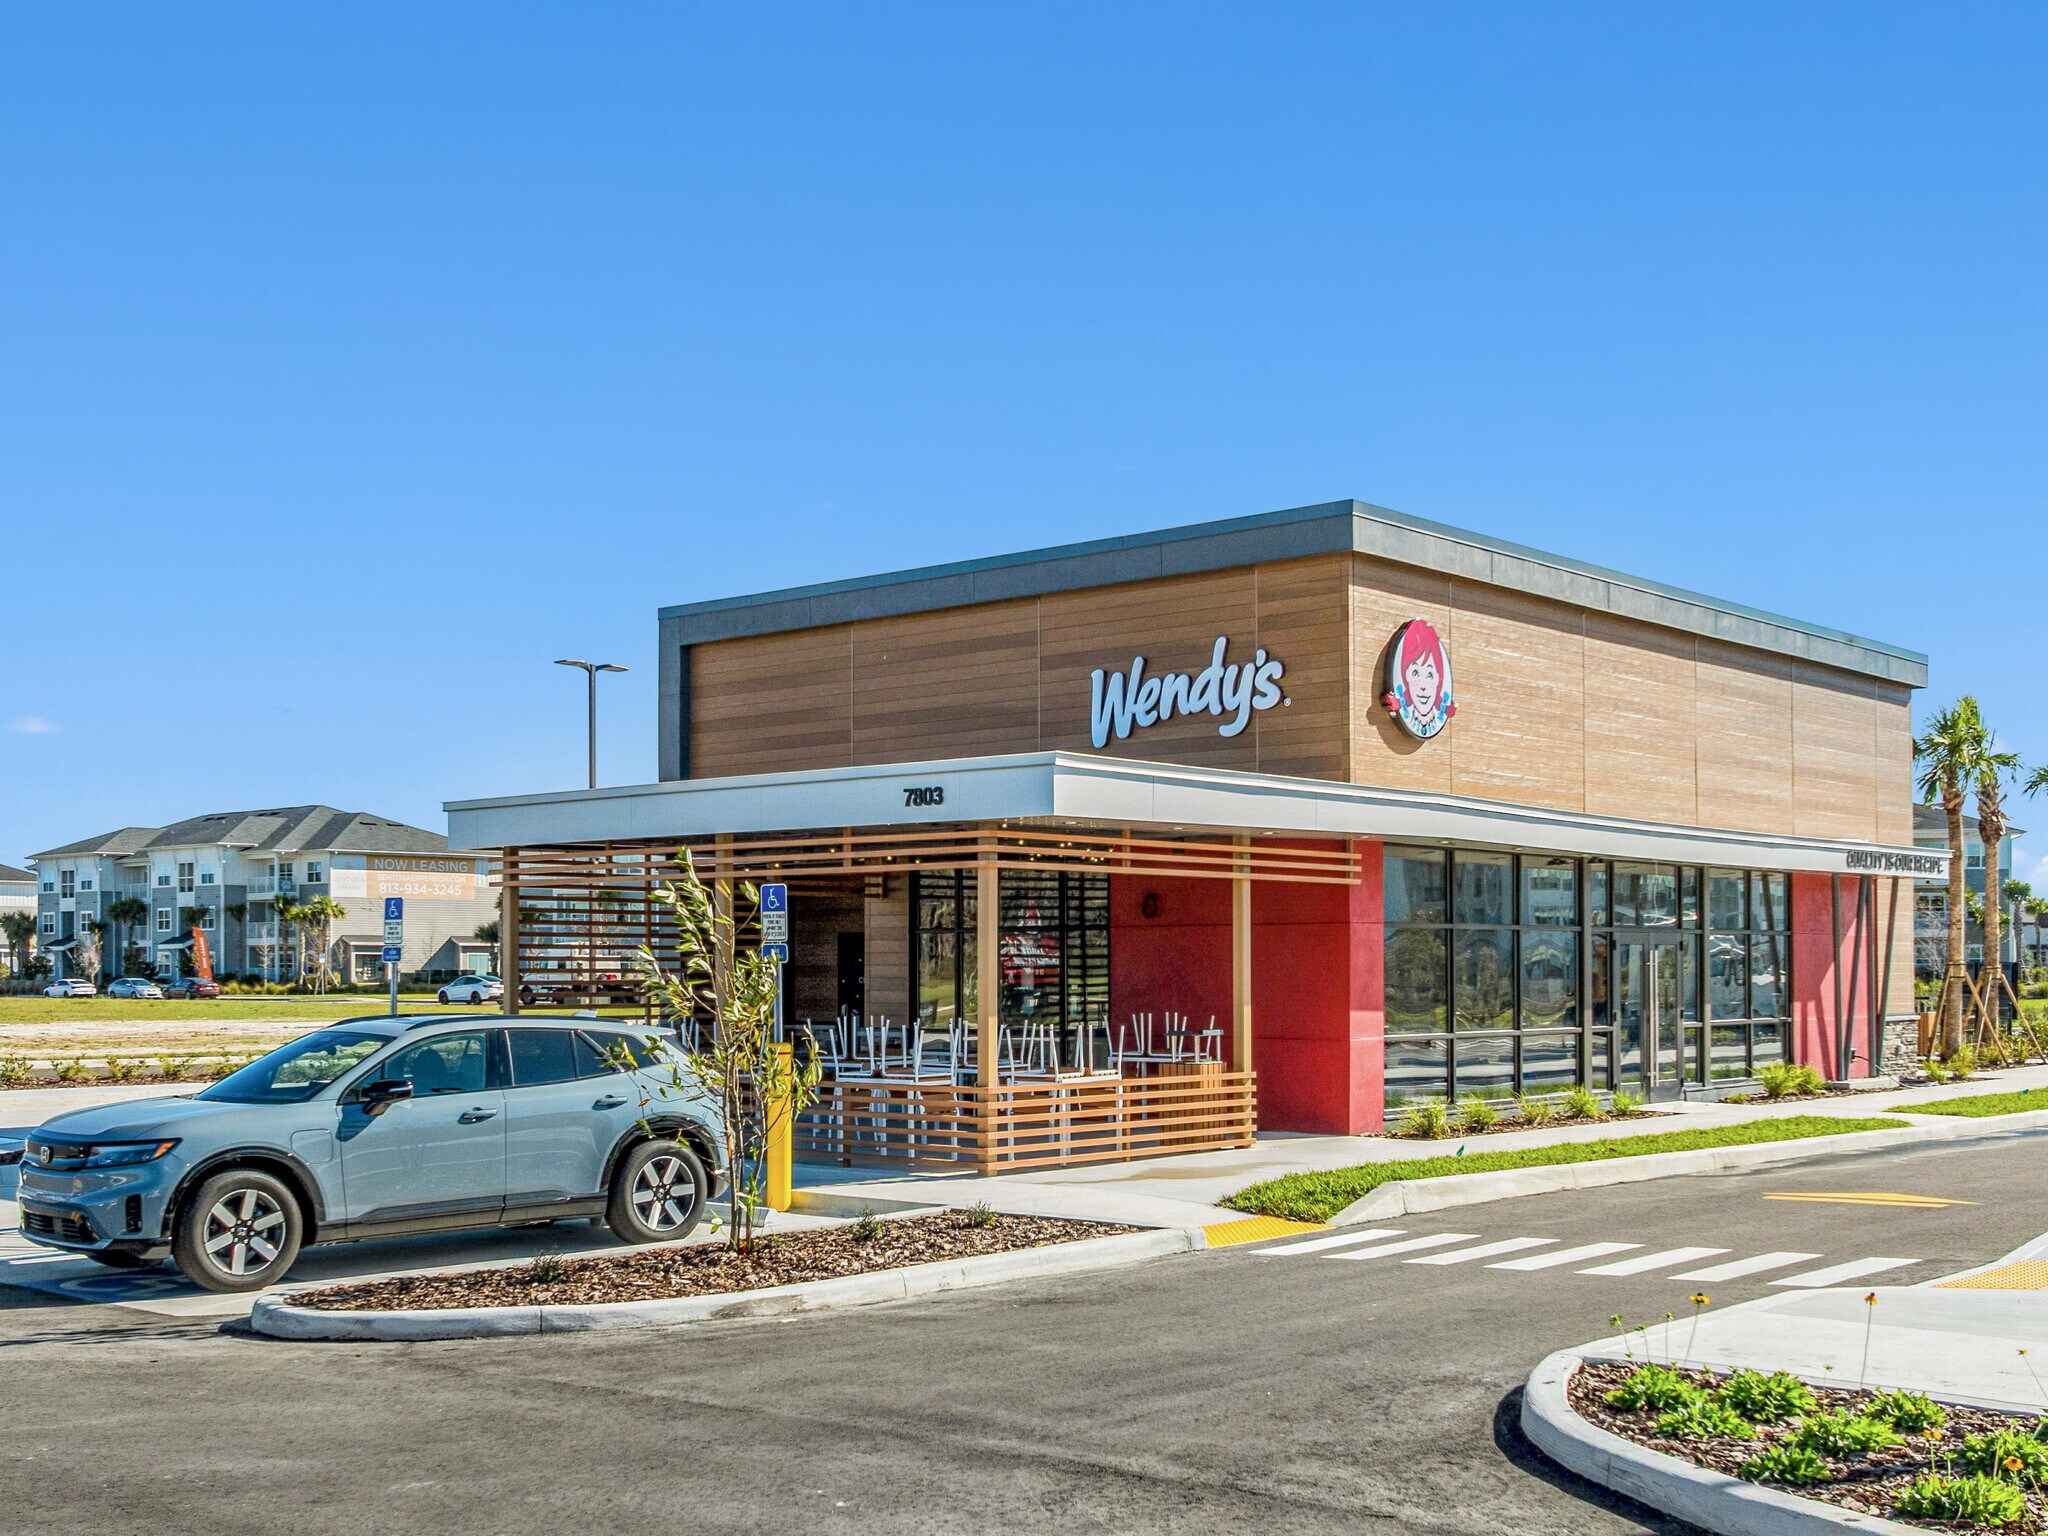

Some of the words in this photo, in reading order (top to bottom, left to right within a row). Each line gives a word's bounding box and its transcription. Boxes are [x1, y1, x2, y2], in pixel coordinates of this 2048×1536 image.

[1091, 636, 1284, 749] Wendy's
[903, 786, 944, 807] 7803
[374, 858, 408, 871] NOW
[412, 860, 468, 873] LEASING
[1846, 850, 1884, 869] QUALITY
[379, 882, 462, 896] 813-934-3245
